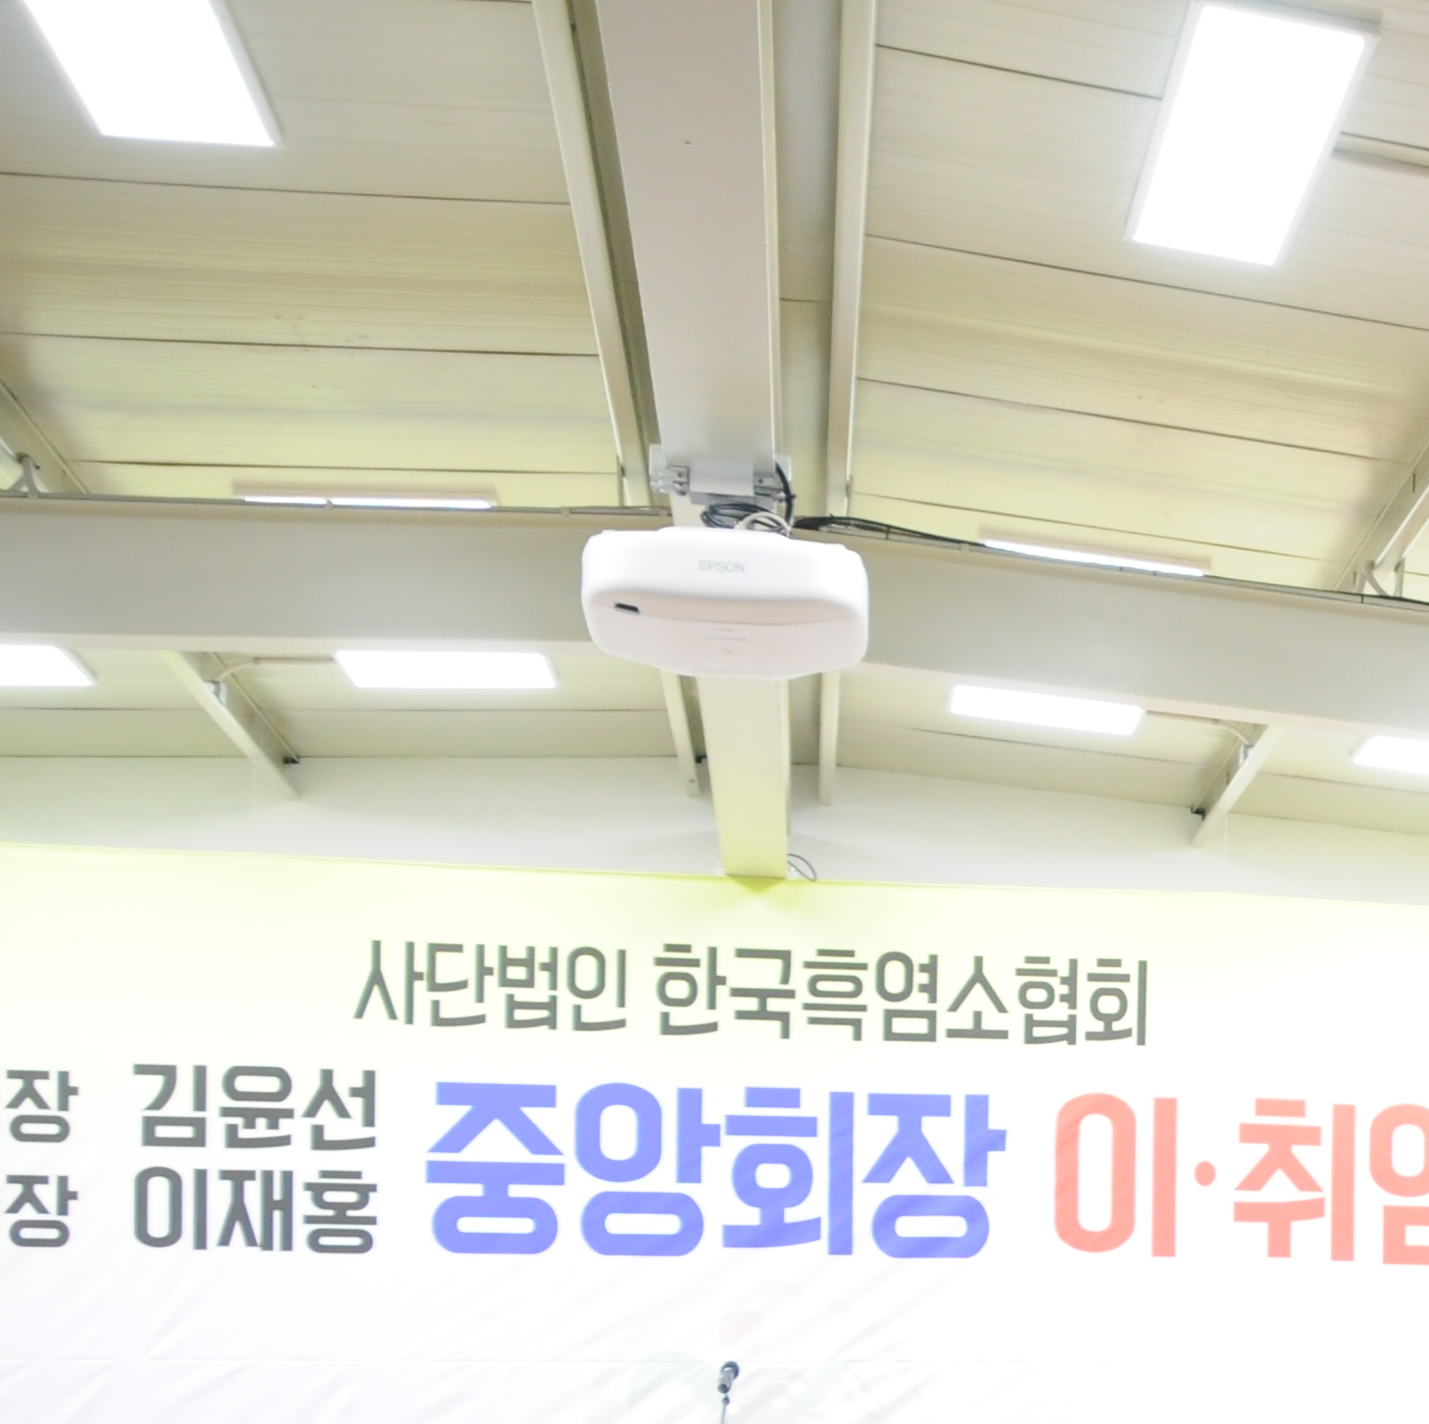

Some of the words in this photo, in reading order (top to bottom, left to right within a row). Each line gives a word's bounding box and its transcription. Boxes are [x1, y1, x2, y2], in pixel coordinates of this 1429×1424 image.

[698, 559, 746, 575] EPSON
[353, 939, 629, 1033] 사단법인
[652, 942, 1149, 1047] 한국흑염소협회
[4, 1068, 80, 1145] 장
[132, 1063, 378, 1152] 김윤선
[4, 1173, 79, 1249] 장
[132, 1165, 378, 1255] 이재홍
[424, 1081, 1010, 1259] 중앙회장
